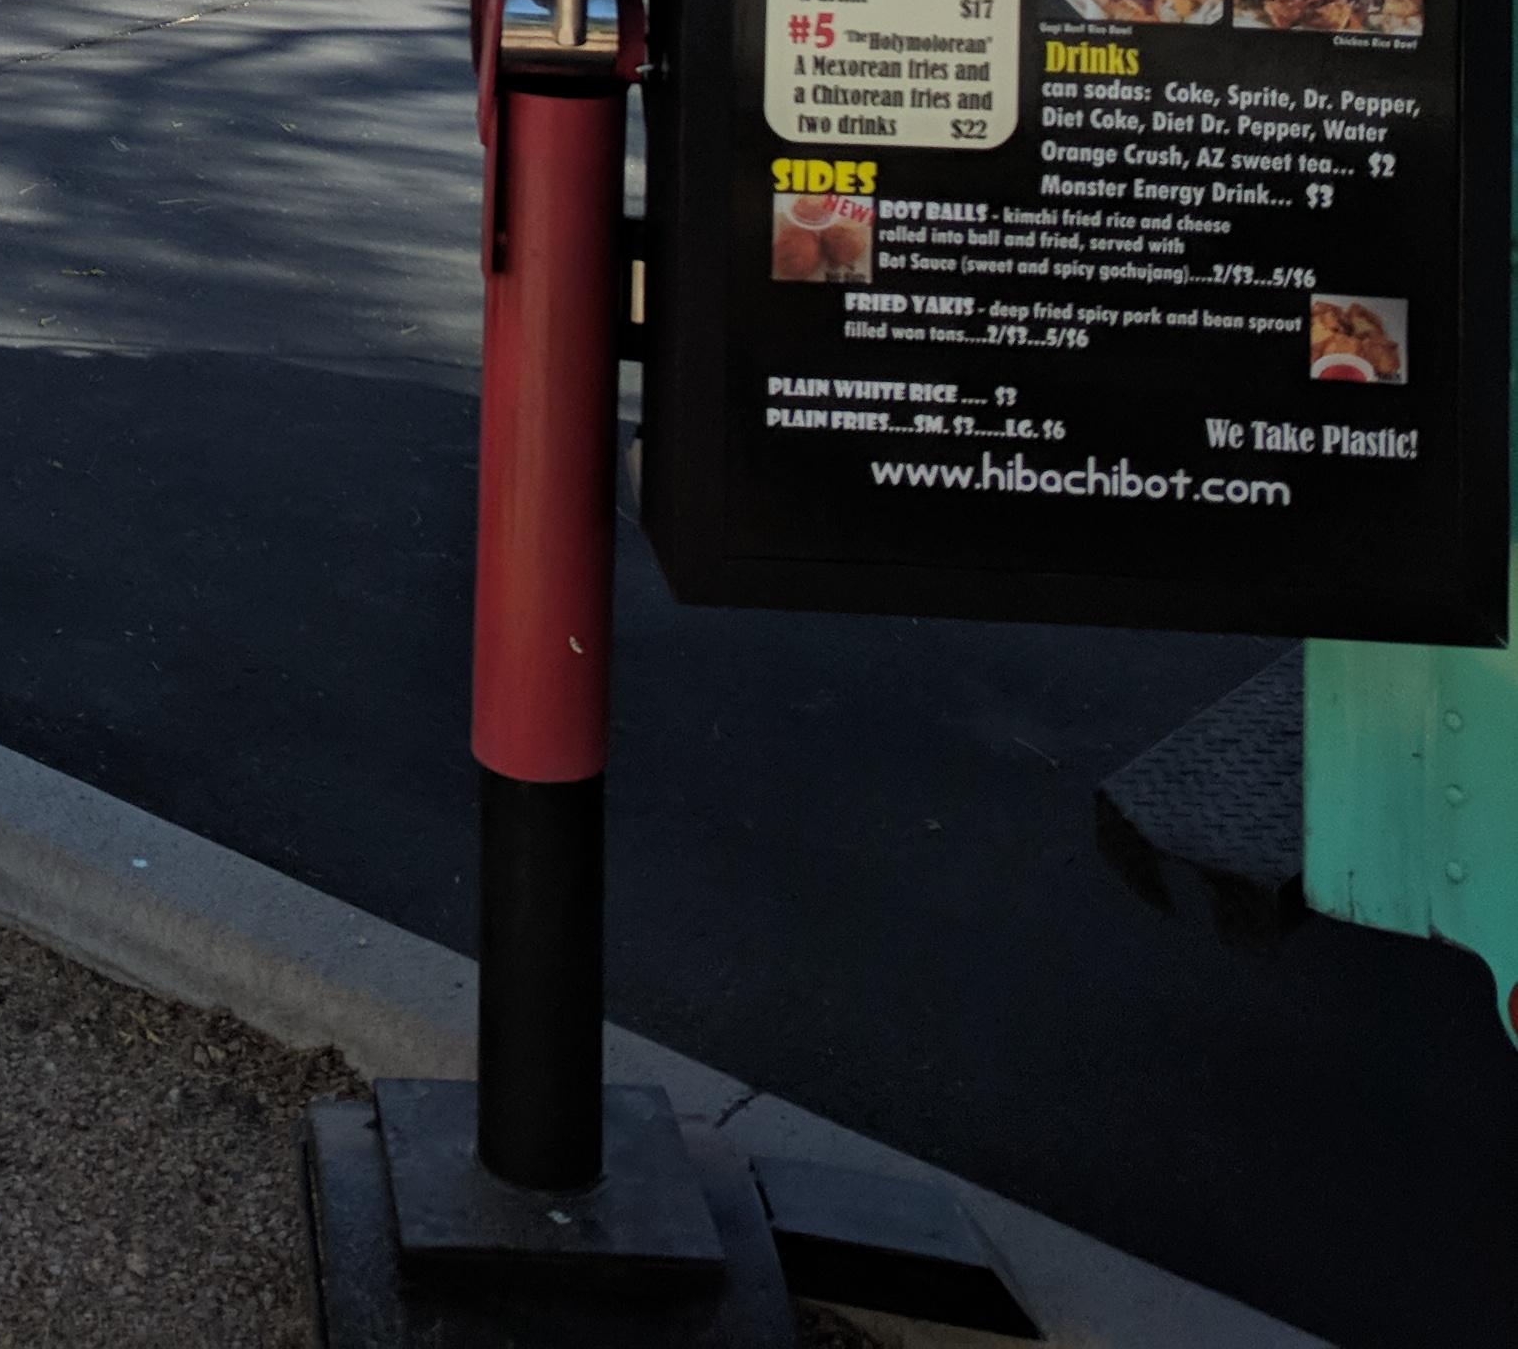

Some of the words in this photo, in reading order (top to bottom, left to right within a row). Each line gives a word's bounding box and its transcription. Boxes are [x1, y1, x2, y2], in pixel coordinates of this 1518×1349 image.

[789, 12, 836, 49] #5
[1044, 41, 1141, 76] Drinks
[1041, 82, 1077, 97] can
[1083, 79, 1150, 100] sodas:
[1164, 81, 1220, 106] Coke,
[1227, 84, 1296, 110] Sprite,
[1303, 88, 1332, 109] Dr.
[1340, 90, 1420, 117] Pepper,
[798, 114, 831, 133] two
[837, 115, 896, 135] drinks
[950, 119, 987, 139] $22
[1042, 106, 1084, 127] Diet
[1089, 108, 1145, 132] Coke,
[1152, 110, 1194, 132] Diet
[1200, 113, 1230, 134] Dr.
[1237, 115, 1316, 141] Pepper,
[1322, 119, 1387, 141] Water
[771, 158, 878, 193] SIDES
[1040, 140, 1117, 166] Orange
[1123, 143, 1189, 168] Crush,
[1196, 147, 1224, 167] AZ
[1230, 153, 1292, 171] sweet
[1368, 151, 1395, 177] $2
[1040, 174, 1127, 196] Monster
[1133, 178, 1205, 205] Energy
[1305, 182, 1333, 208] $3
[821, 195, 876, 226] NEW!
[878, 199, 923, 219] BOT
[925, 201, 988, 221] BALLS
[1003, 207, 1058, 224] kimchi
[1062, 209, 1101, 226] fried
[1106, 212, 1136, 228] rice
[1140, 213, 1172, 230] and
[1176, 214, 1230, 233] cheese
[768, 377, 829, 396] PLAIN
[832, 379, 906, 400] WHITE
[908, 383, 957, 402] RICE
[994, 386, 1016, 405] $3
[766, 408, 828, 427] PLAIN
[1042, 419, 1065, 439] $6
[1205, 418, 1243, 447] We
[1250, 421, 1314, 451] Take
[1322, 425, 1417, 457] Plastic!
[870, 451, 1291, 506] www.hibachibot.com
